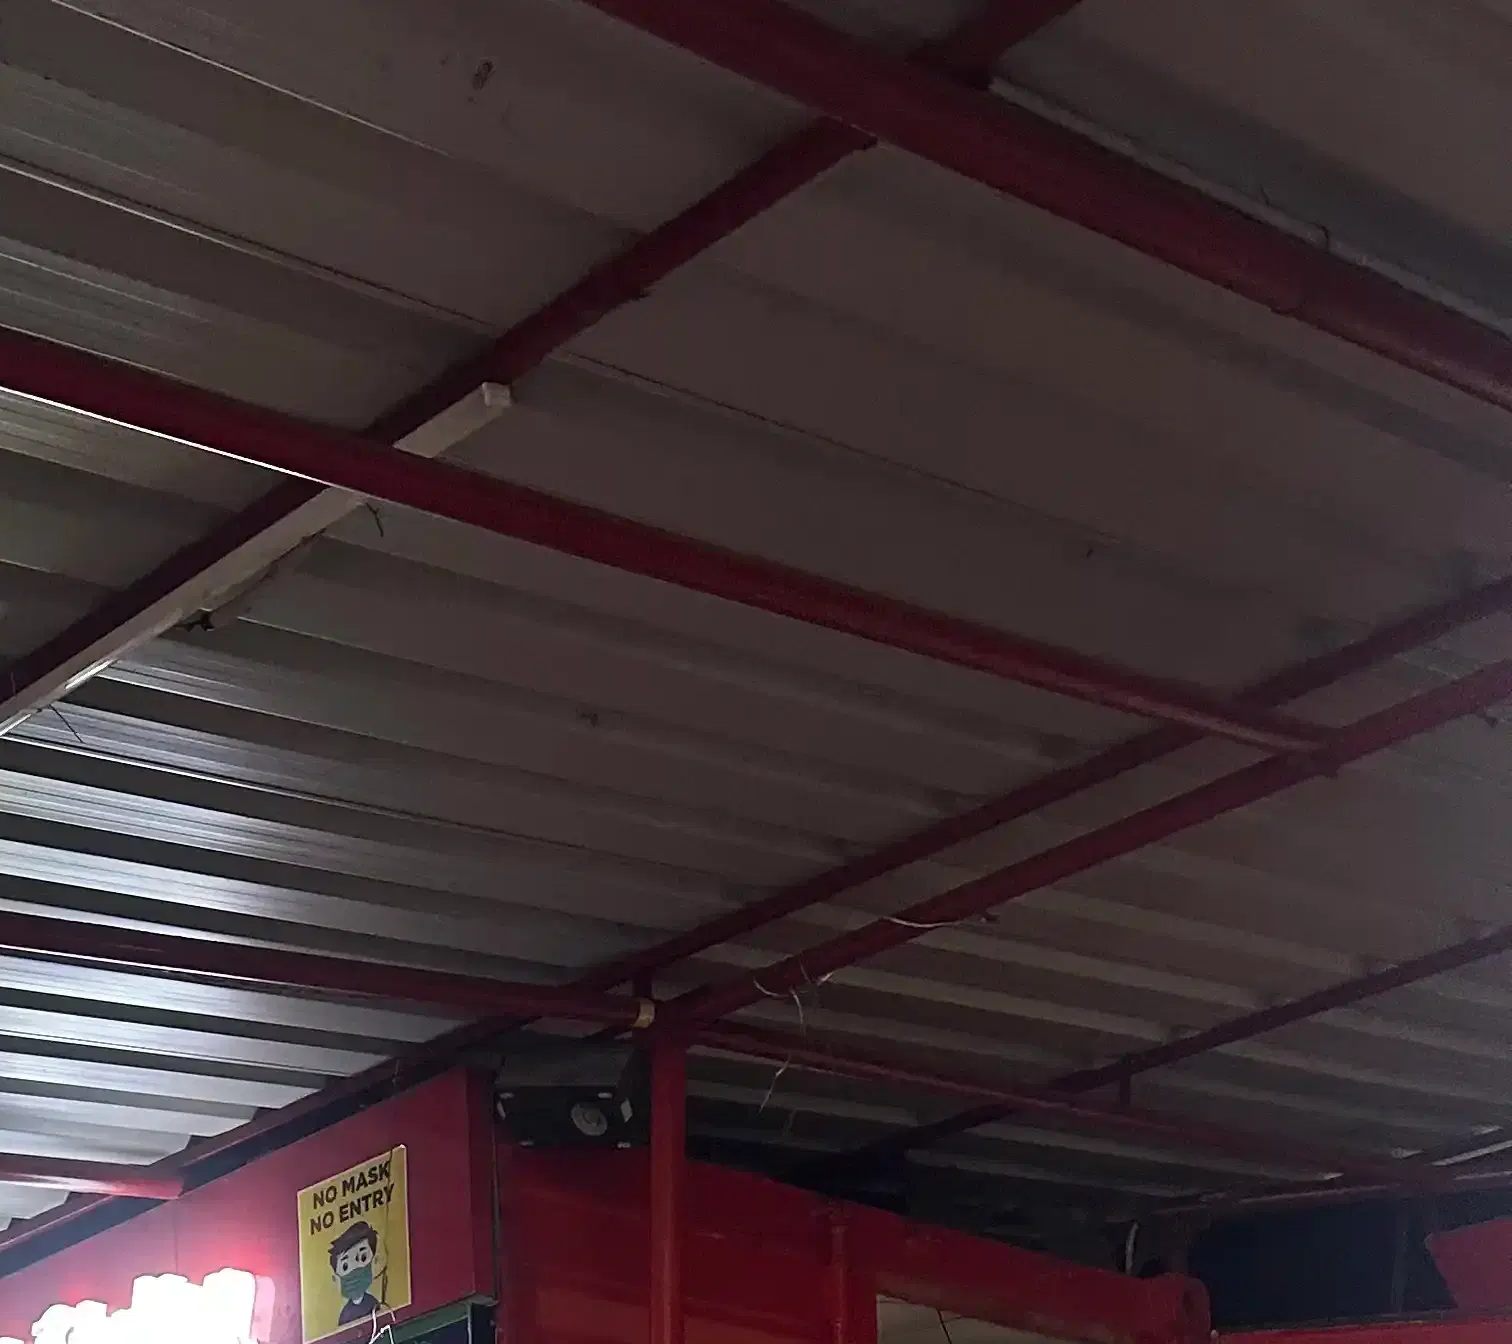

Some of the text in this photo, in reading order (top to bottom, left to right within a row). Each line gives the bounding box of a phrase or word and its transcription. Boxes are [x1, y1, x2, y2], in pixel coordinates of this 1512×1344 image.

[312, 1159, 392, 1209] NO MASK
[310, 1184, 395, 1235] NO ENTRY
